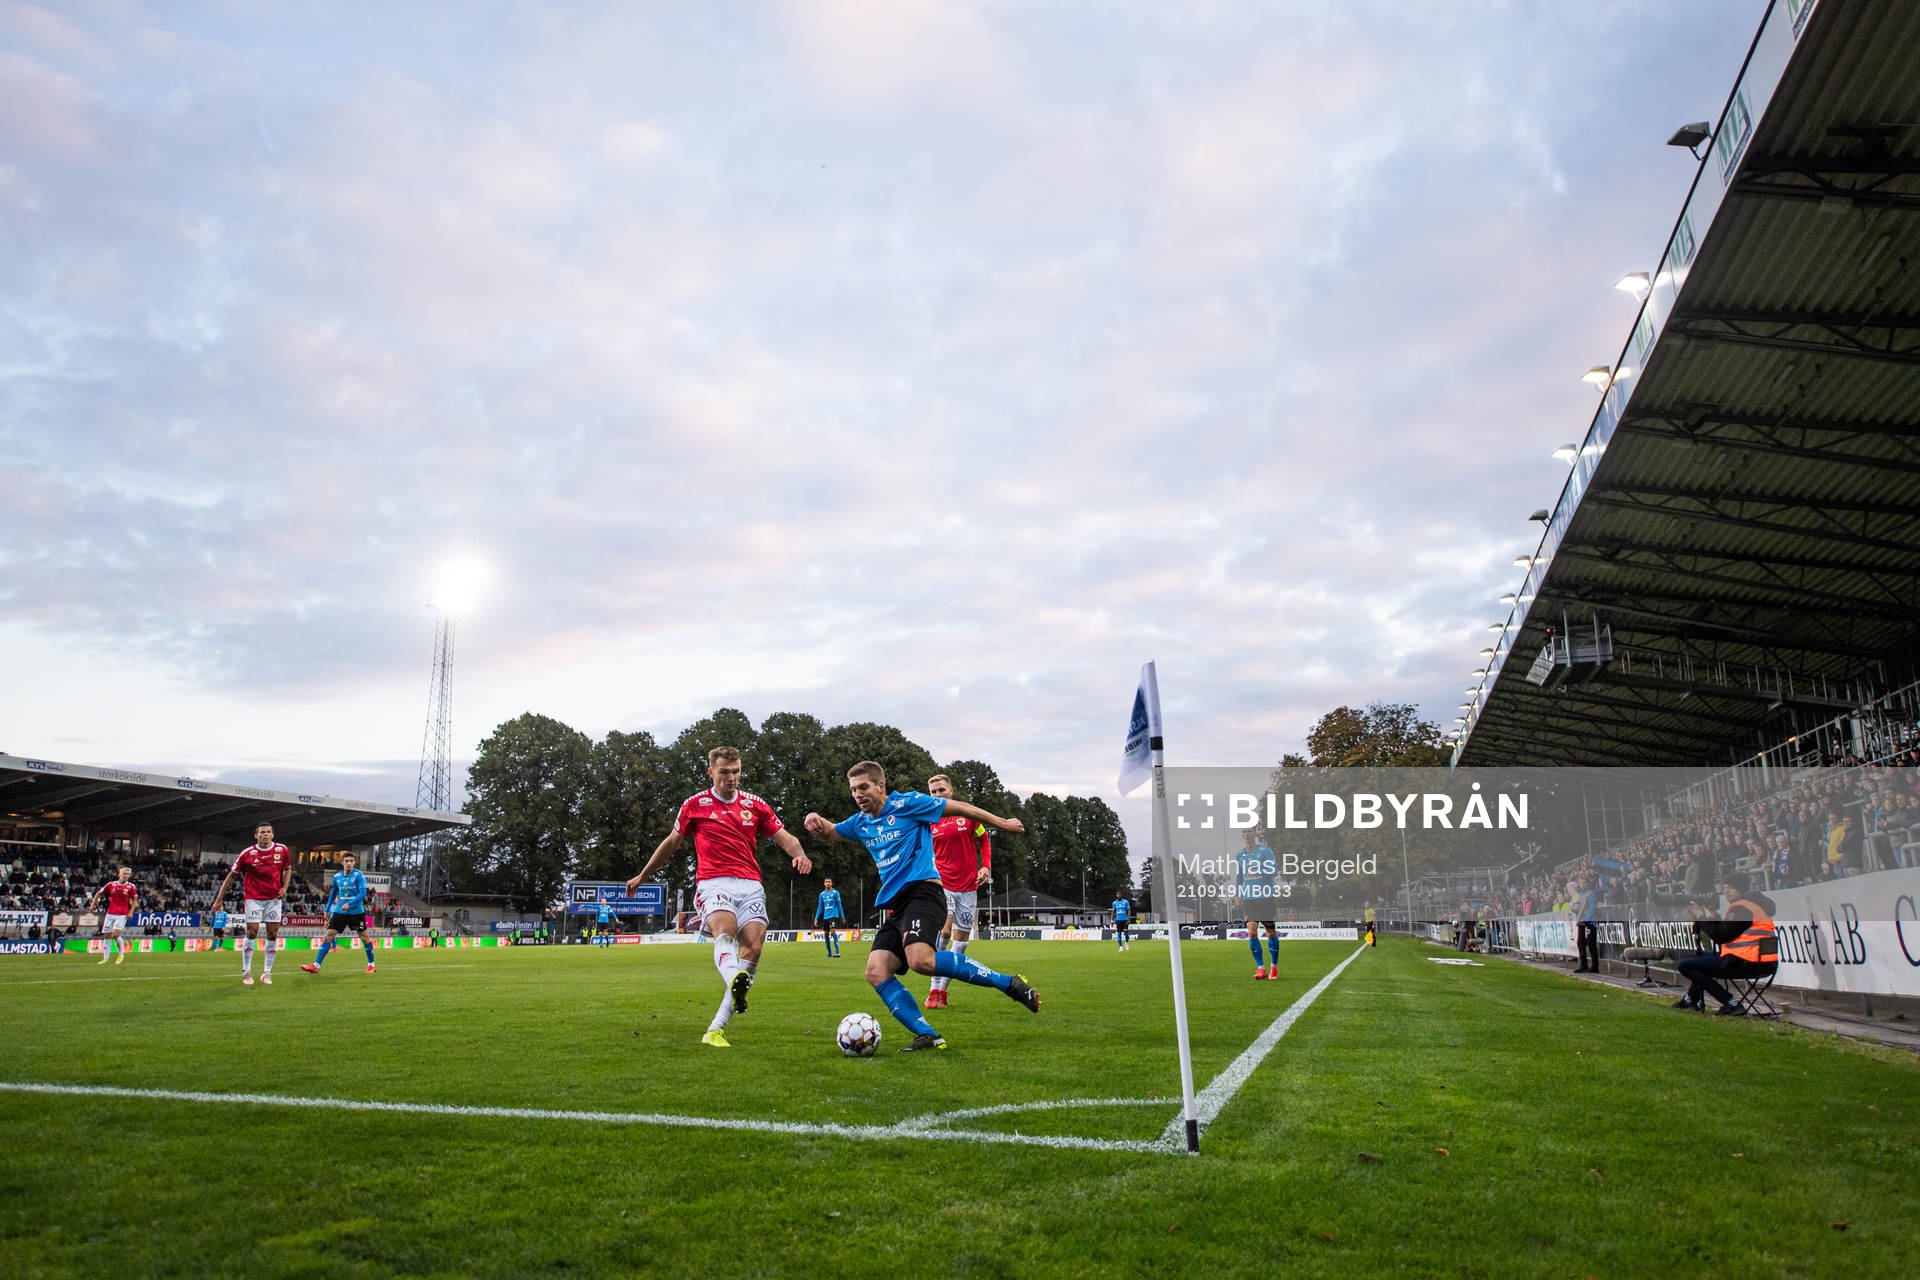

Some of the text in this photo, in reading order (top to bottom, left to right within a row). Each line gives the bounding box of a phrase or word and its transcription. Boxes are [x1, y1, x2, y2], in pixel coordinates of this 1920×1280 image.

[1154, 764, 1165, 799] SELECT
[865, 830, 901, 848] GETINGE
[576, 888, 596, 900] NP
[603, 891, 616, 899] NP
[912, 919, 920, 928] 14
[1053, 931, 1089, 940] office
[1829, 902, 1867, 965] AB
